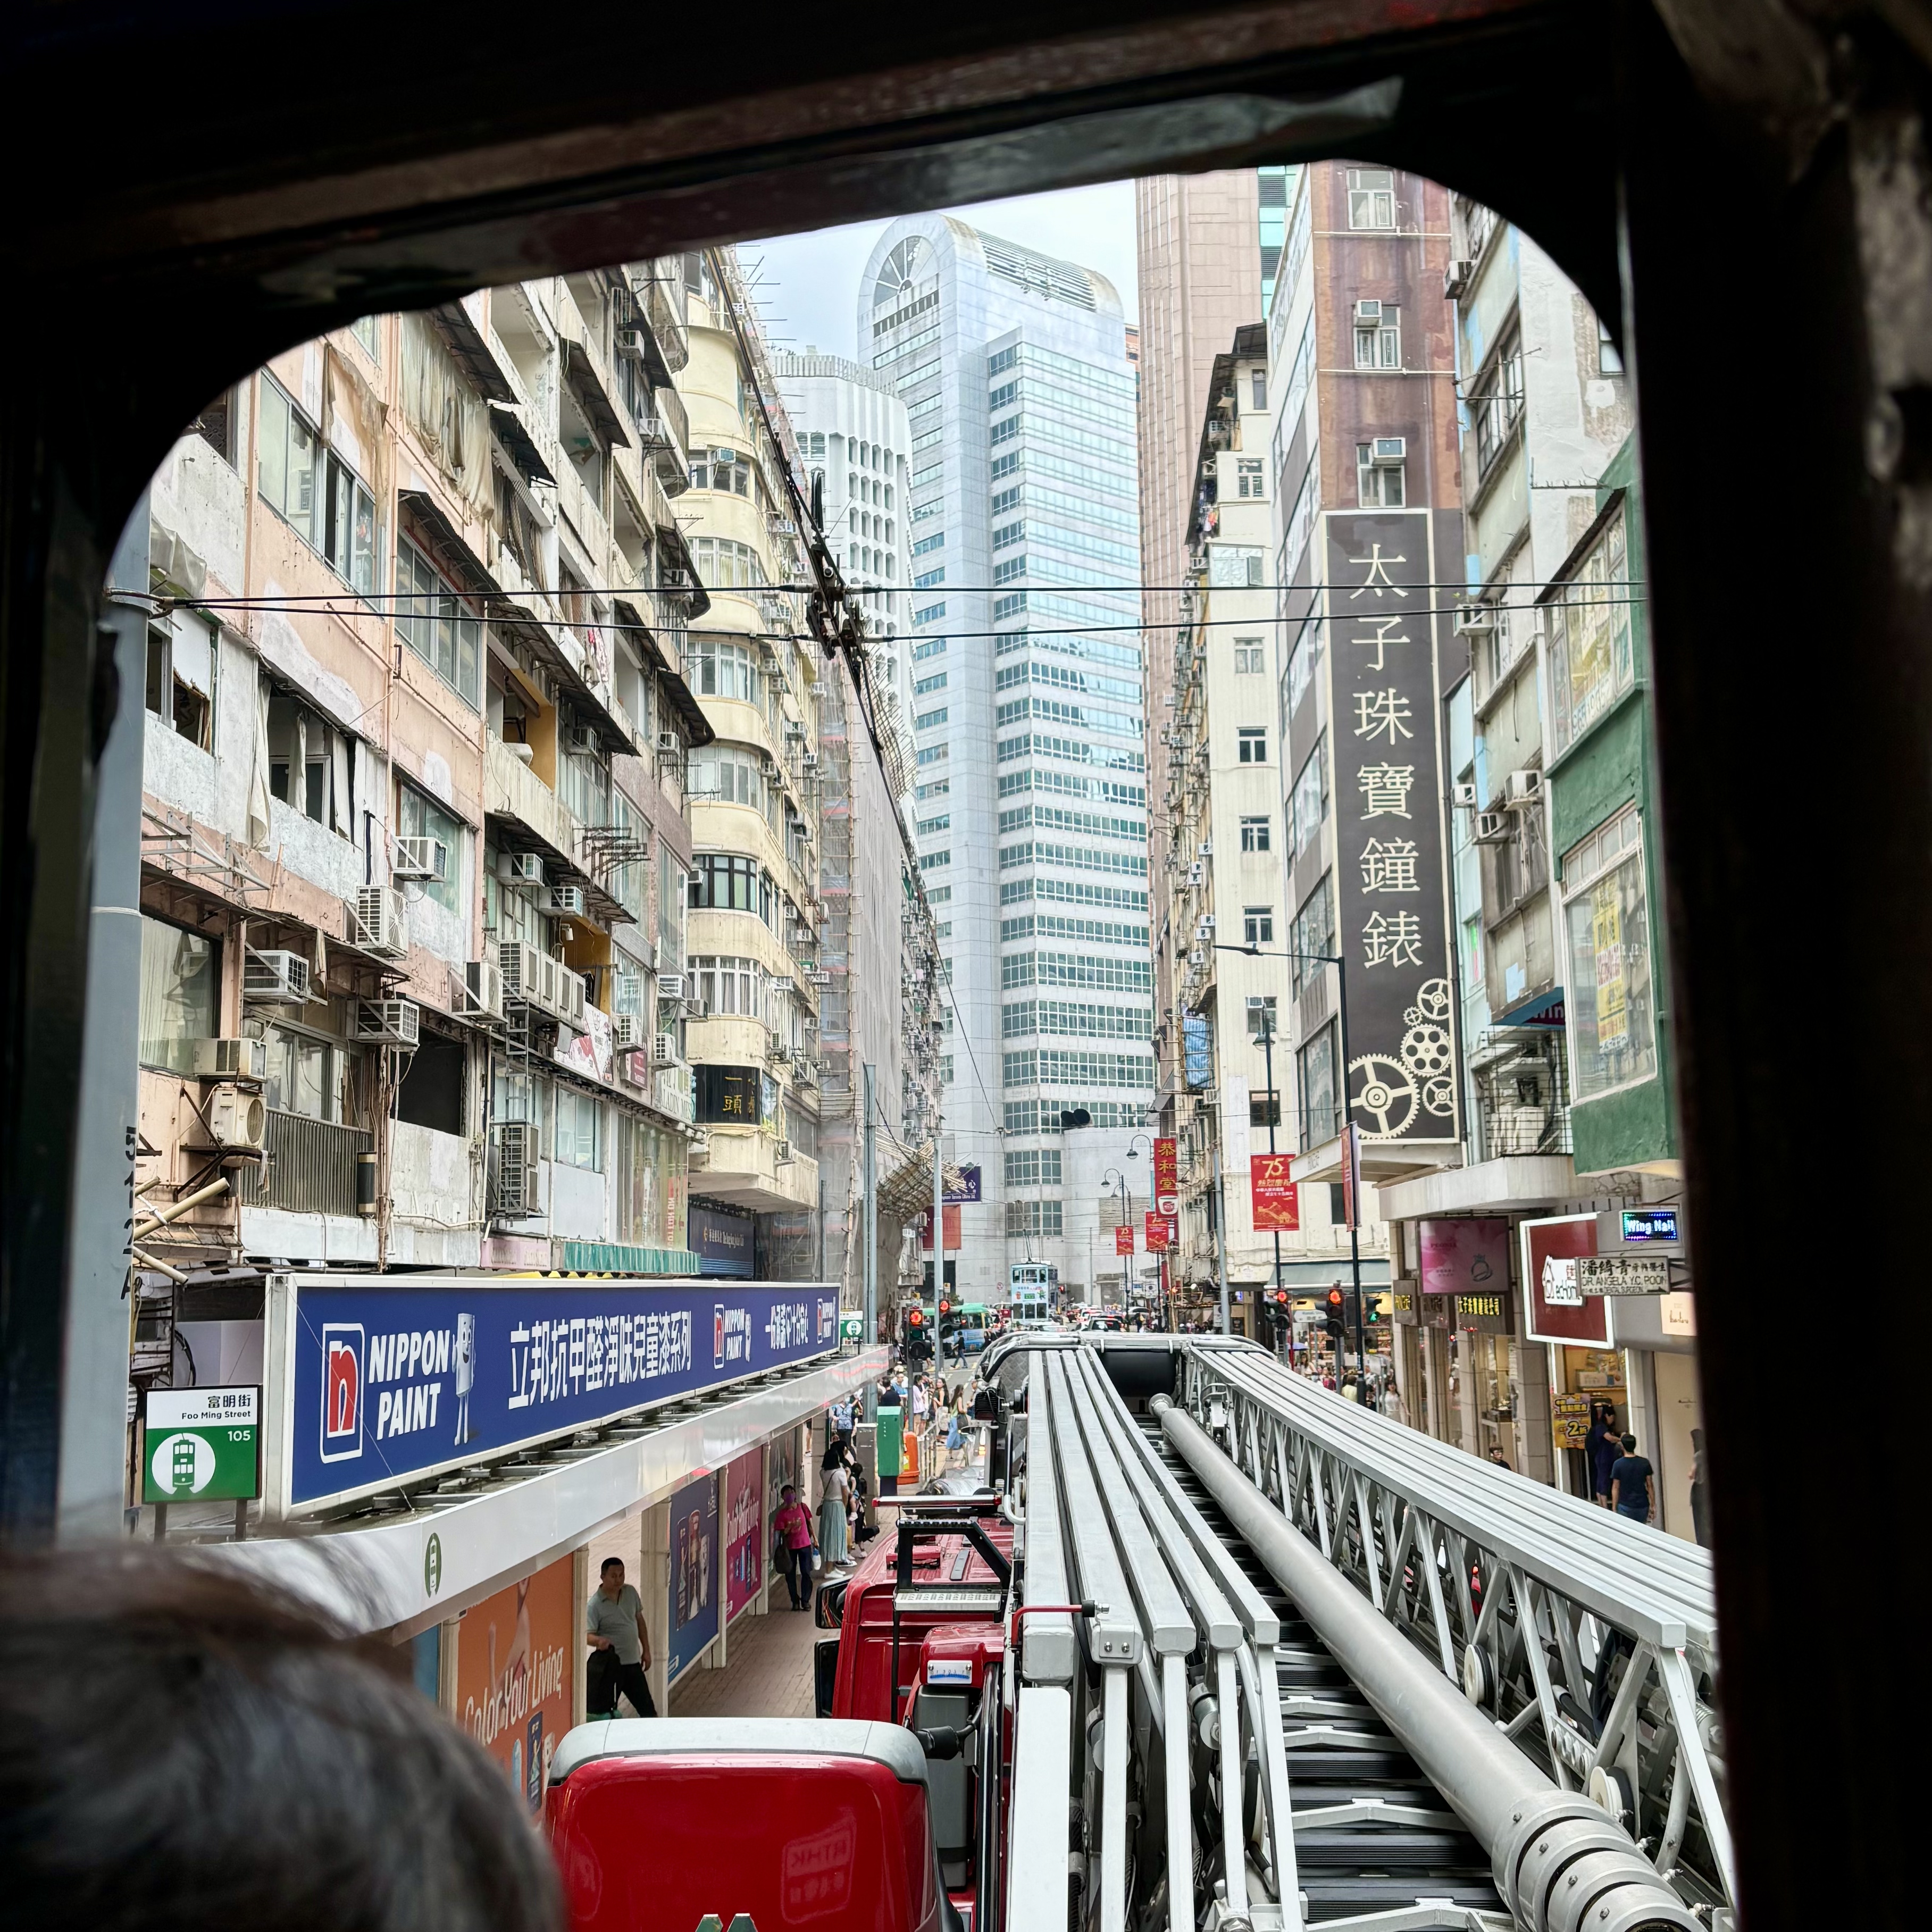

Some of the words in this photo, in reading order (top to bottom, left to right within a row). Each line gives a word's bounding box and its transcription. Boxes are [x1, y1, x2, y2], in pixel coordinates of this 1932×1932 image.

[1349, 543, 1424, 969] 太子珠寶鐘錶
[1158, 1142, 1176, 1191] 恭和堂
[1261, 1158, 1285, 1178] 75
[1627, 1219, 1652, 1235] Wing
[1653, 1219, 1675, 1232] Nail
[1596, 1276, 1627, 1286] ANGELA
[1644, 1275, 1666, 1285] POON
[725, 1308, 745, 1333] NIPPON
[369, 1329, 450, 1384] NIPPON
[508, 1310, 691, 1410] 立邦抗甲醛淨味兒童漆系列
[726, 1335, 742, 1360] PAINT
[207, 1394, 251, 1408] 富明街
[377, 1383, 441, 1440] PAINT
[201, 1410, 222, 1420] Ming
[225, 1410, 251, 1419] Street
[228, 1430, 251, 1442] 105
[505, 1666, 531, 1730] Your
[532, 1645, 564, 1700] Living
